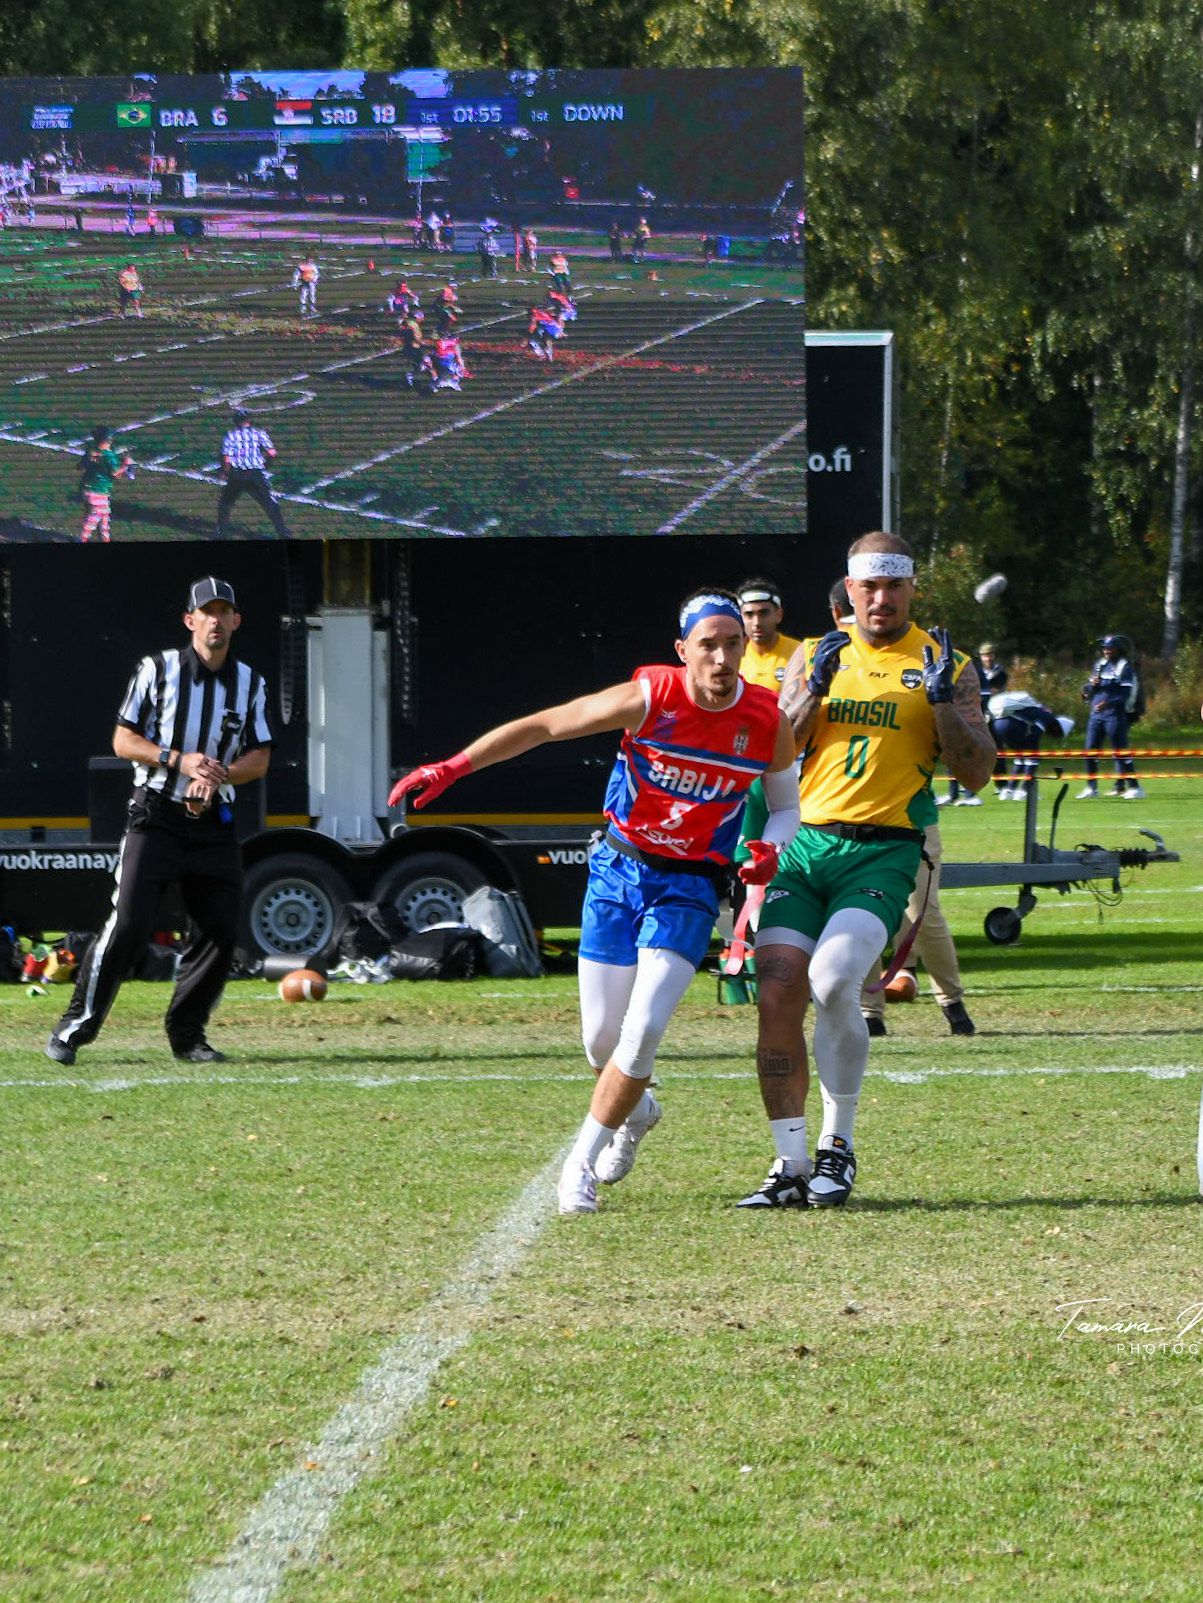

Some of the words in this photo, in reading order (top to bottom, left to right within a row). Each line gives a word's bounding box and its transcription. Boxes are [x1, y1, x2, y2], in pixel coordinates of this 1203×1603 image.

[160, 109, 198, 127] BRA
[212, 106, 229, 126] 6
[321, 107, 358, 124] SRB
[372, 104, 396, 123] 18
[453, 105, 502, 123] 01:55
[564, 104, 625, 122] DOWN
[808, 448, 852, 472] o.fi
[828, 698, 902, 730] BRASIL
[844, 735, 870, 778] 0
[548, 849, 590, 865] vuo
